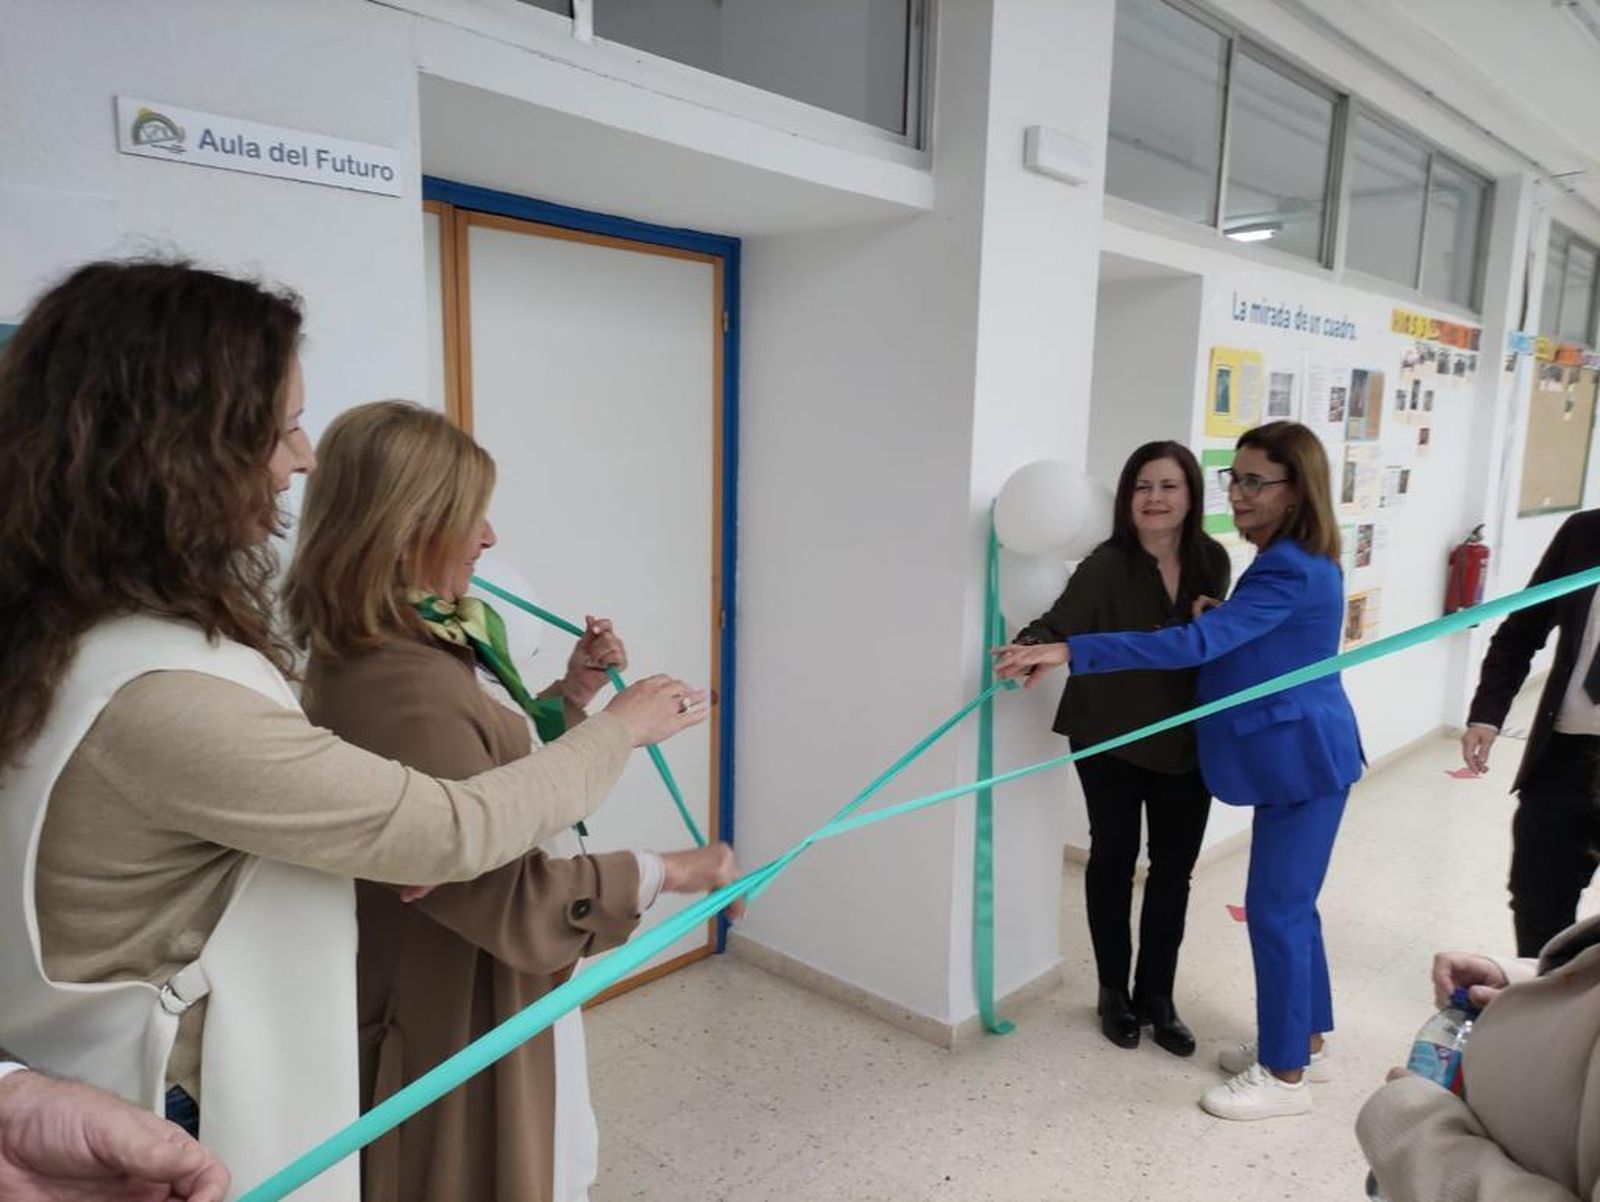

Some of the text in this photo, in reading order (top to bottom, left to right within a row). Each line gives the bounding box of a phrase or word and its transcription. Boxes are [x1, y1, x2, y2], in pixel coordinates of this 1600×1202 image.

[198, 129, 394, 182] Aula del Futuro
[1232, 291, 1246, 321] La
[1250, 298, 1290, 328] mirada
[1294, 305, 1307, 331] de
[1310, 316, 1321, 335] un
